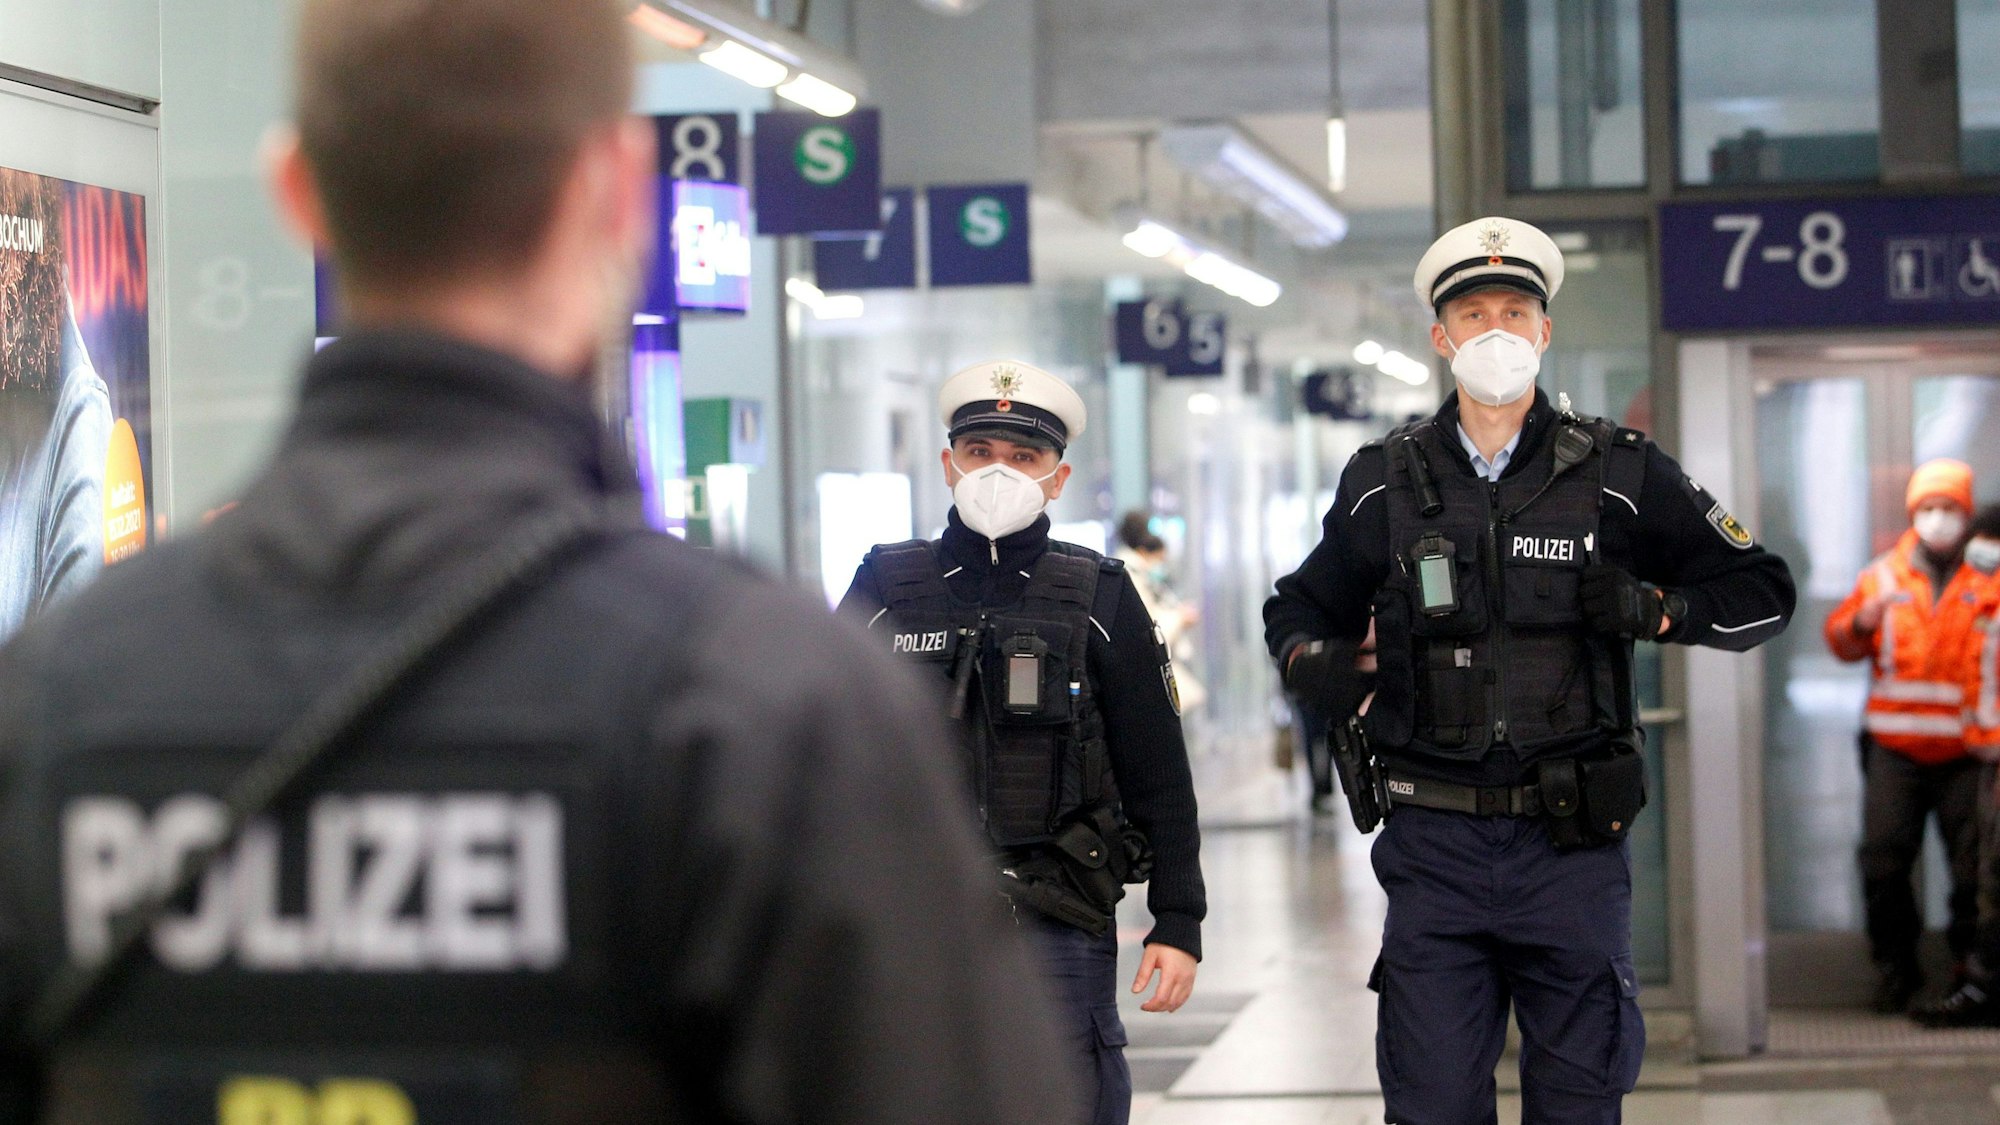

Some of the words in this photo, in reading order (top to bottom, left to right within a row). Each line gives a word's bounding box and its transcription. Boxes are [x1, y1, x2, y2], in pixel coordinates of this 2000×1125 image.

[671, 116, 725, 180] 8
[800, 126, 849, 184] S
[963, 198, 1005, 246] S
[1712, 211, 1849, 290] 7-8
[1143, 299, 1181, 350] 6
[1187, 311, 1222, 365] 5
[1512, 535, 1574, 561] POLIZEI
[893, 630, 948, 653] POLIZEI
[62, 793, 568, 972] POLIZEI
